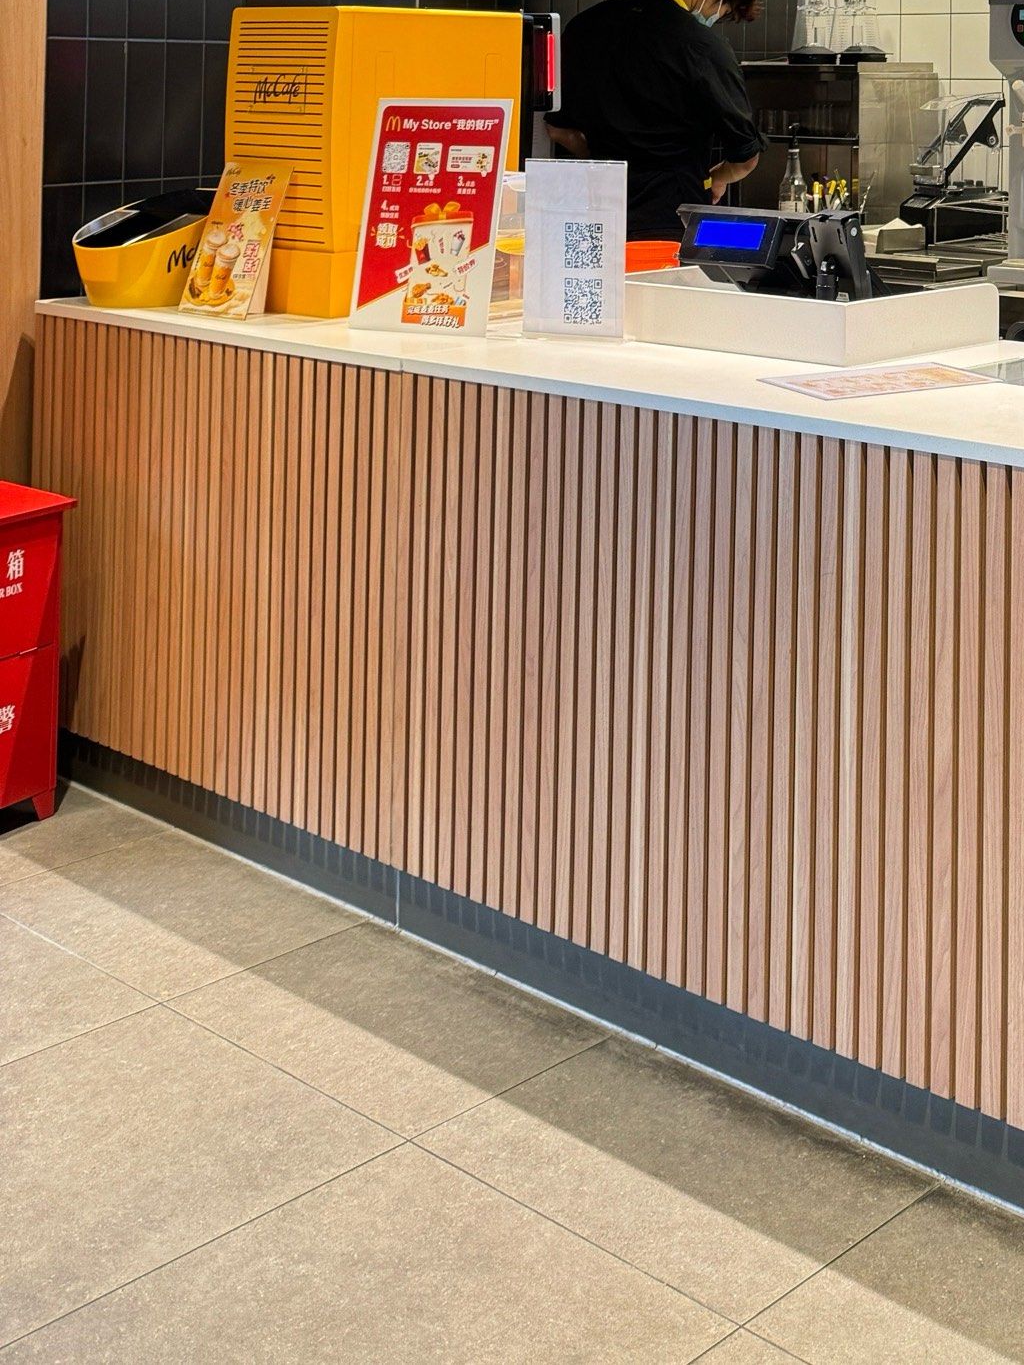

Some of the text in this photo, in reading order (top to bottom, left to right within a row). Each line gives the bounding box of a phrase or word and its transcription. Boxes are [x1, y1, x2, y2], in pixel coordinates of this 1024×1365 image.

[402, 118, 419, 132] My
[7, 548, 25, 581] 箱
[6, 582, 23, 597] BOX
